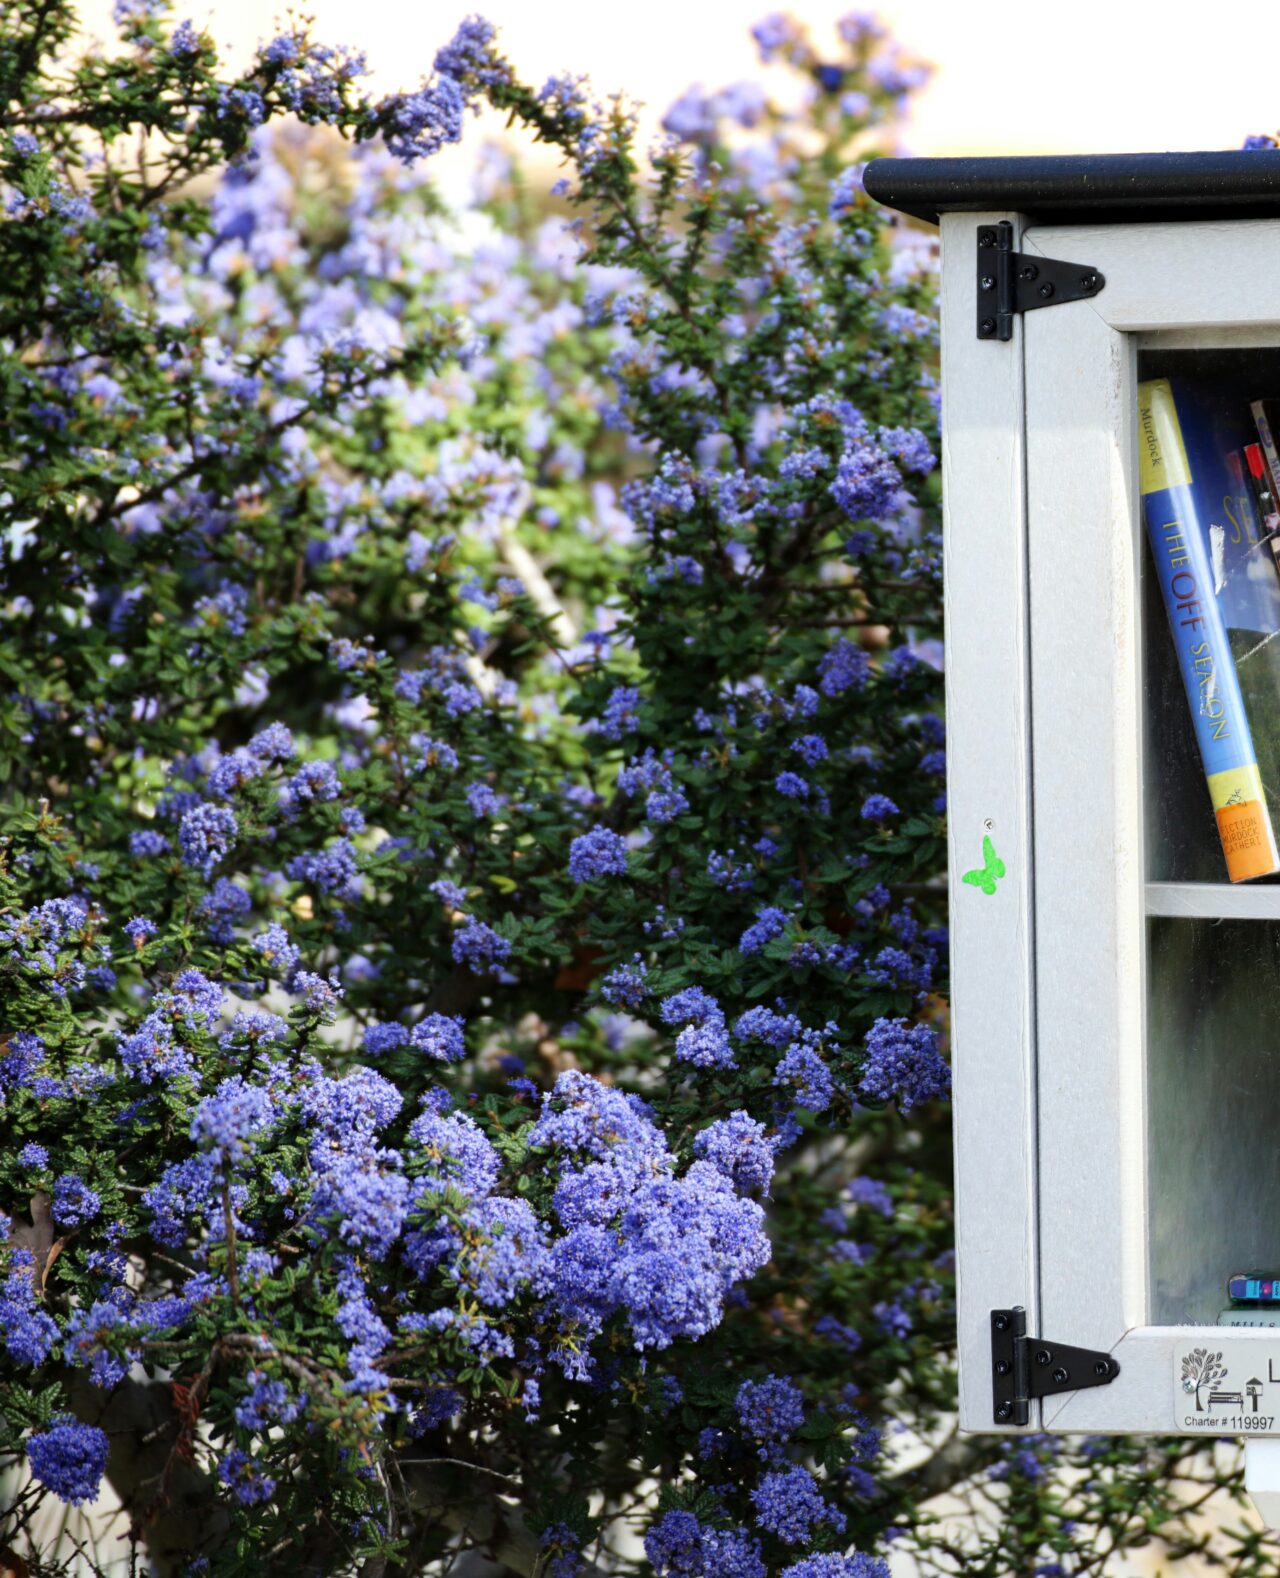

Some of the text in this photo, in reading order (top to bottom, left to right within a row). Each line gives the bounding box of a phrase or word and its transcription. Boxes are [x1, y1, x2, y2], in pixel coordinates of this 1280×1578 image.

[1141, 407, 1163, 466] Murdock
[1162, 521, 1231, 742] THE OFF SEASON
[1184, 1416, 1275, 1430] Charter # 119997
